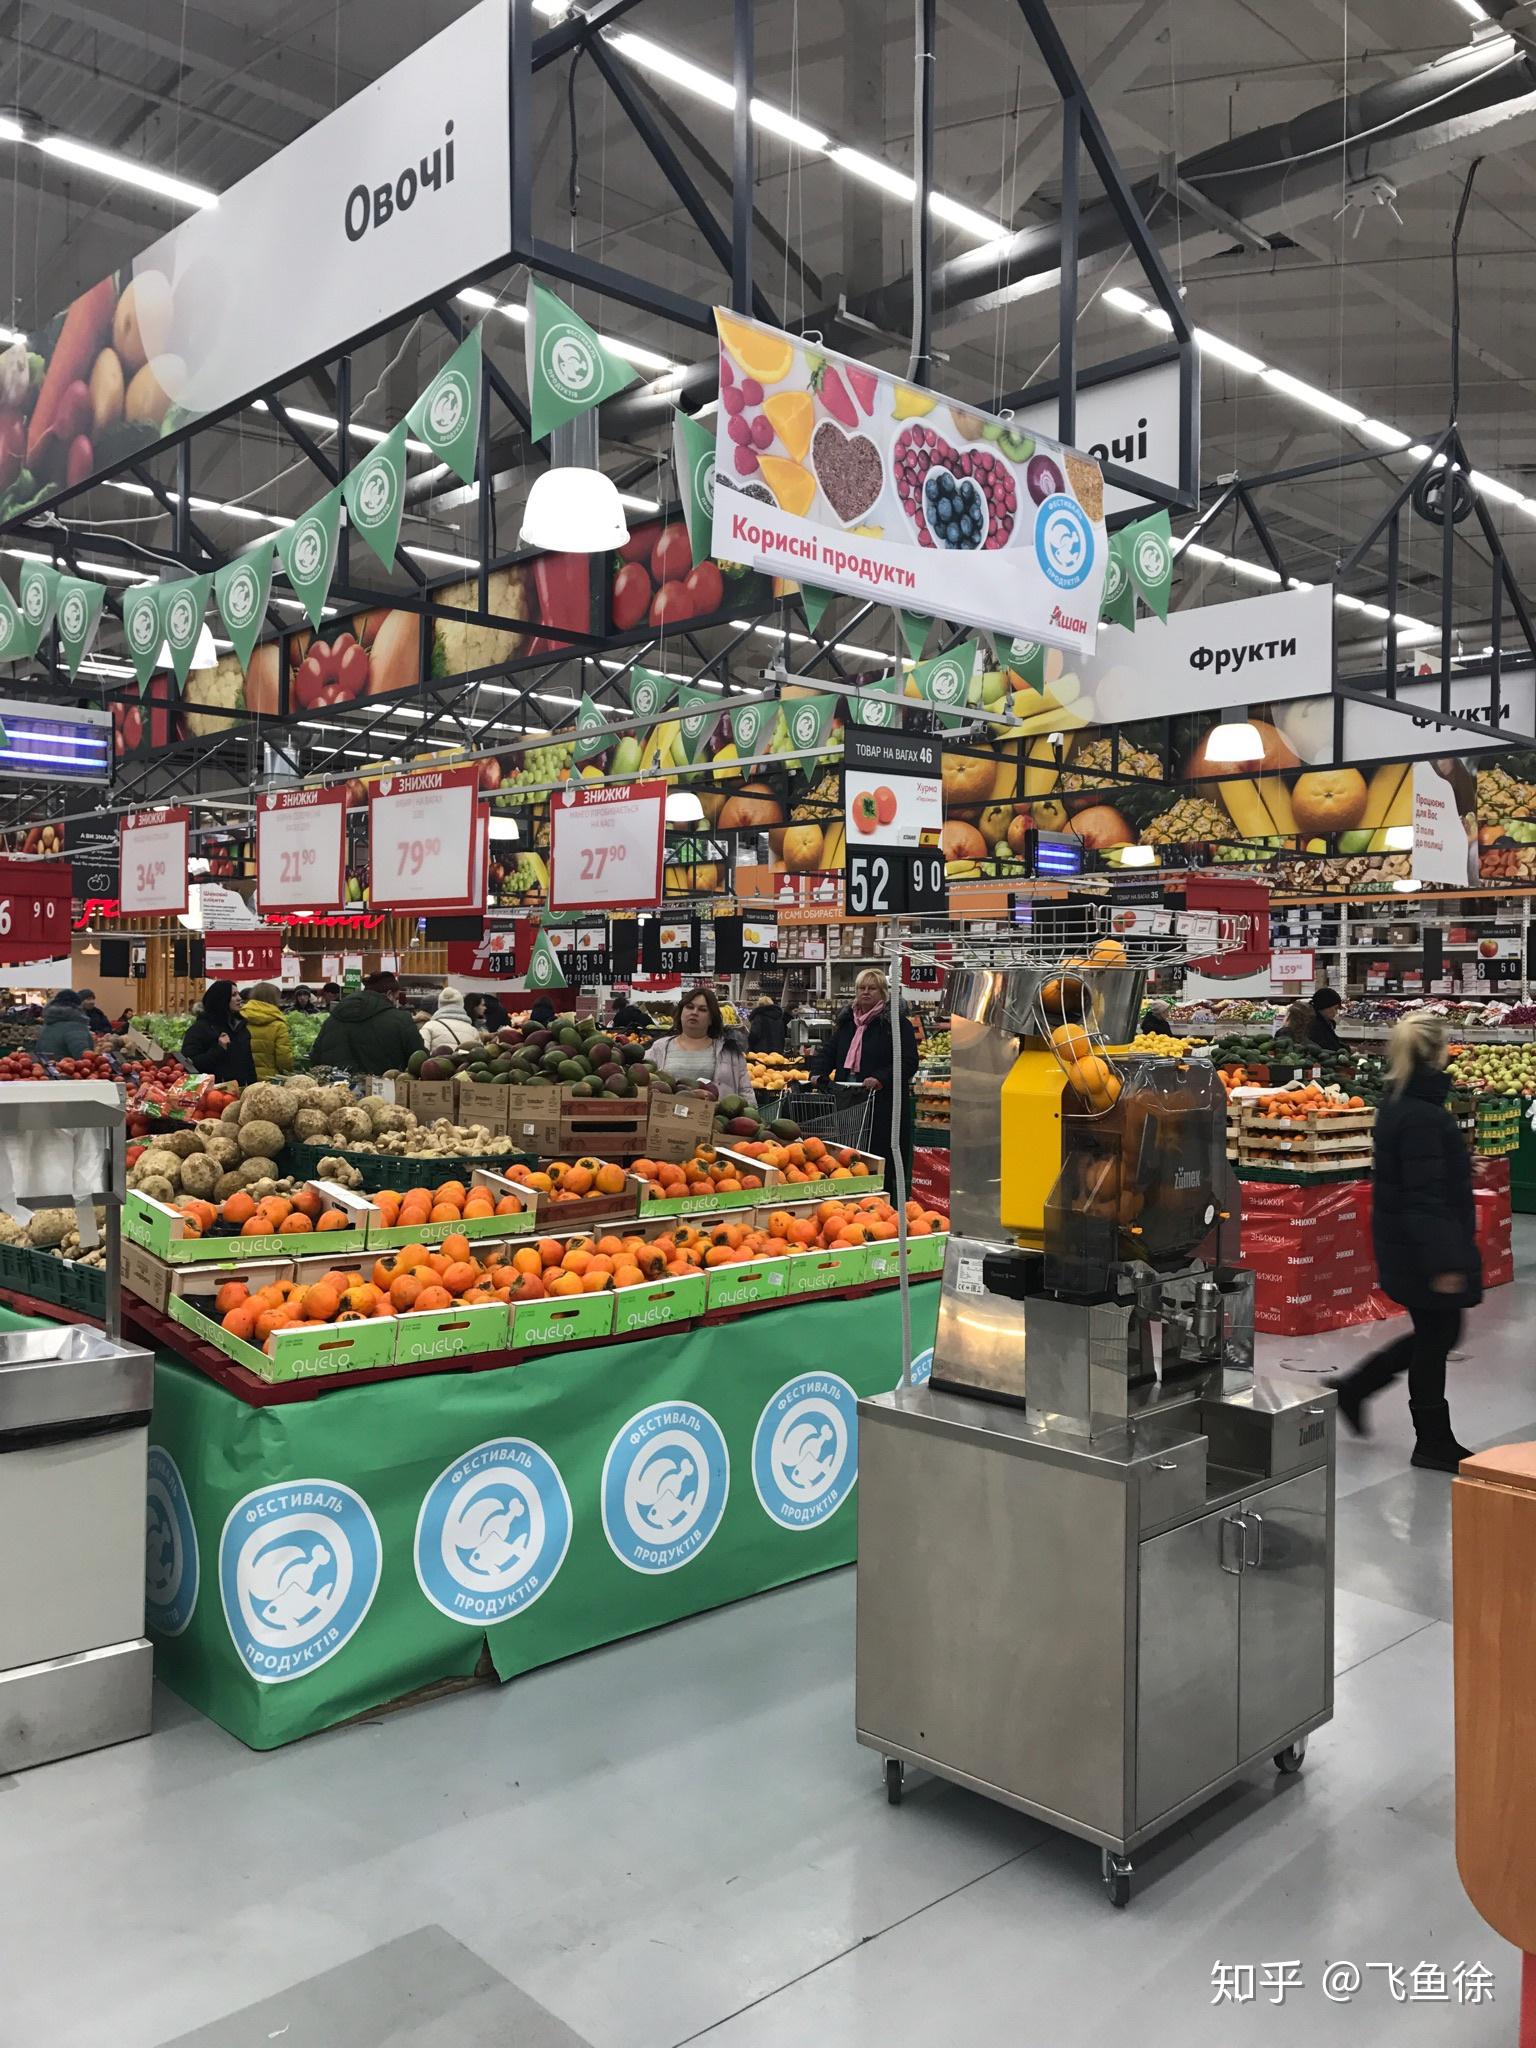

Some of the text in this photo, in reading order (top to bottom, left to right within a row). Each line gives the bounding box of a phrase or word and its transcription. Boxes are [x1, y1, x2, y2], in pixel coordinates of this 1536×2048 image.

[345, 120, 454, 242] Овочі
[1088, 418, 1147, 463] очі
[1048, 499, 1083, 520] ФЕСТИВАЛЬ
[732, 514, 916, 589] Корисні продукти
[1049, 605, 1088, 634] Ашан
[1189, 638, 1296, 675] Фрукти
[856, 744, 932, 764] ТОВАР НА ВАГАХ 46
[398, 773, 442, 792] ЗНИЖКИ
[916, 782, 938, 794] Хурма
[282, 791, 318, 807] ЗНИЖКИ
[583, 786, 631, 804] ЗНИЖКИ
[138, 812, 166, 826] ЗНИЖКИ
[851, 857, 941, 912] 52 90
[1151, 891, 1159, 899] 35
[785, 910, 801, 920] САМІ
[804, 908, 843, 919] ОБИРАЄТЕ
[237, 949, 255, 968] 12
[489, 956, 501, 972] 23
[576, 954, 588, 971] 35
[661, 951, 674, 969] 53
[743, 951, 758, 969] 27
[911, 968, 921, 981] 23
[1290, 1218, 1317, 1226] ЗНИЖКИ
[1251, 1232, 1285, 1243] ЗНИЖКИ
[1288, 1256, 1314, 1265] ЗНИЖКИ
[1256, 1271, 1283, 1282] НИЖКИ
[777, 1381, 841, 1411] ФЕСТИВАЛЬ
[630, 1412, 701, 1445] ФЕСТИВАЛЬ
[450, 1448, 533, 1484] ФЕСТИВАЛЬ
[246, 1491, 344, 1524] ФЕСТИВАЛЬ
[780, 1488, 839, 1523] ПРОДУКТІВ
[634, 1528, 702, 1566] ПРОДУКТІВ
[454, 1575, 539, 1616] ПРОДУКТІВ
[245, 1626, 340, 1674] ПРОДУКТІВ
